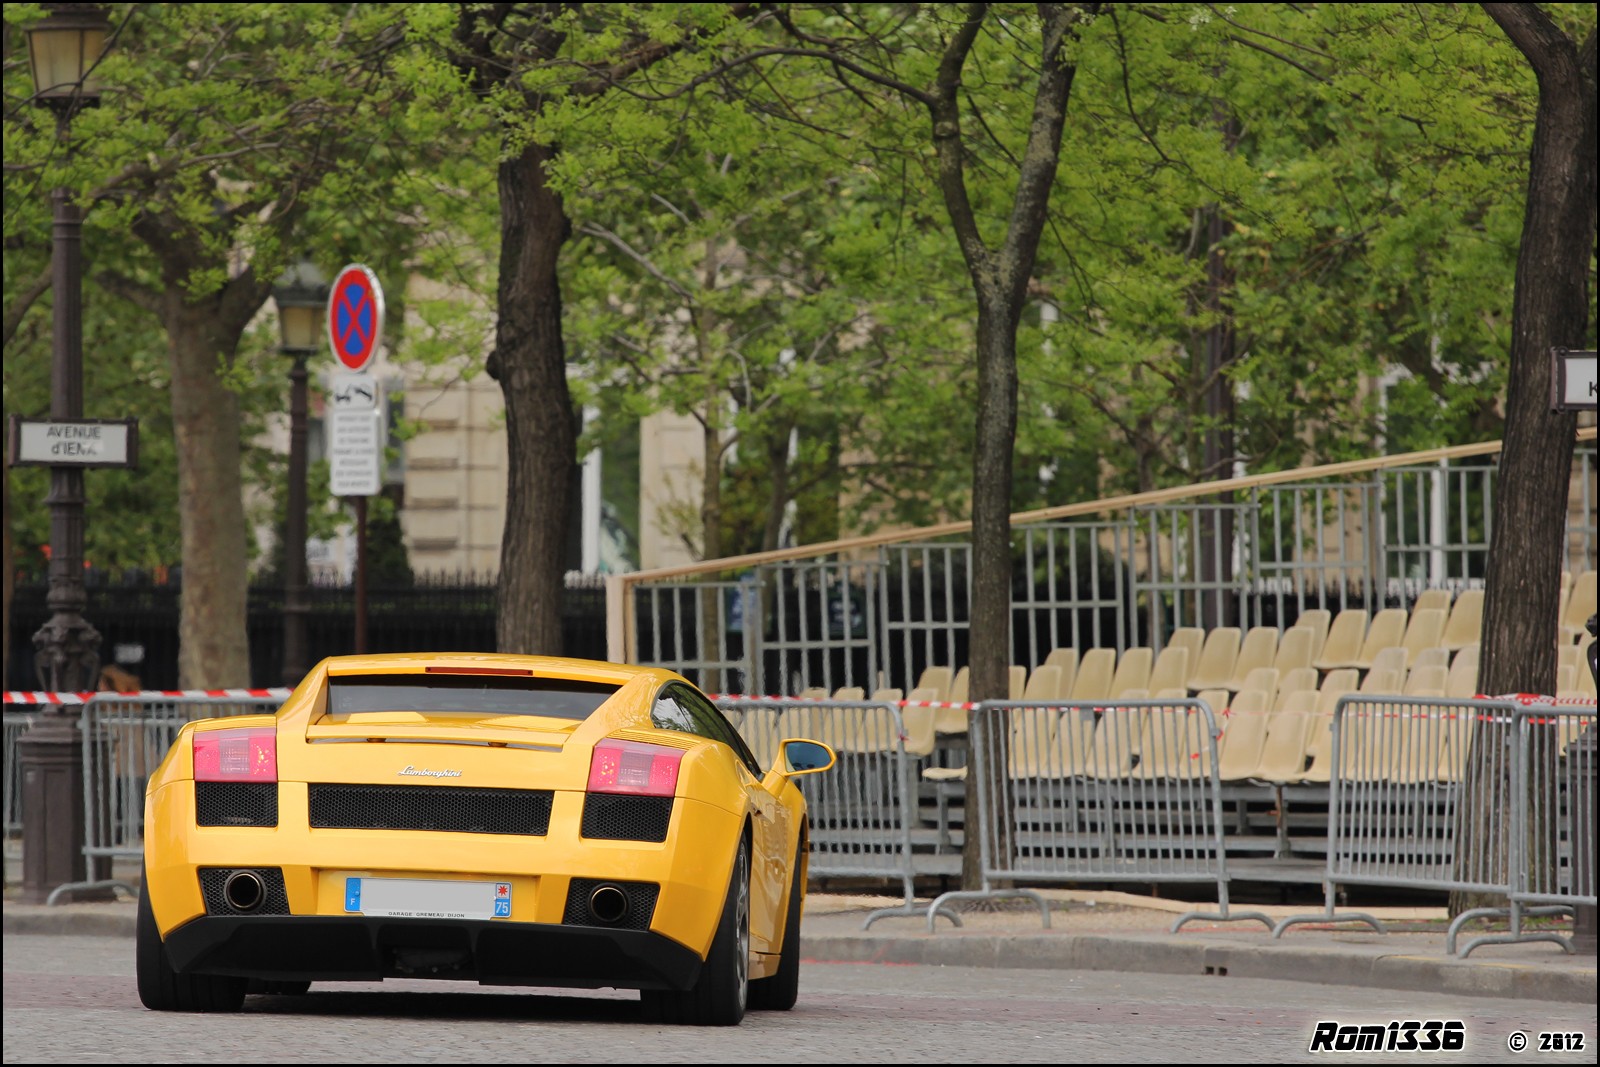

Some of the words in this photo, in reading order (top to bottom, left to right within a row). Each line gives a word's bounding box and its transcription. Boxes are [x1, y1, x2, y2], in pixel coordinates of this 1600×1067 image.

[47, 425, 102, 439] AVENUE
[398, 765, 463, 778] Lamborghini
[350, 898, 356, 906] F
[496, 901, 508, 914] 75
